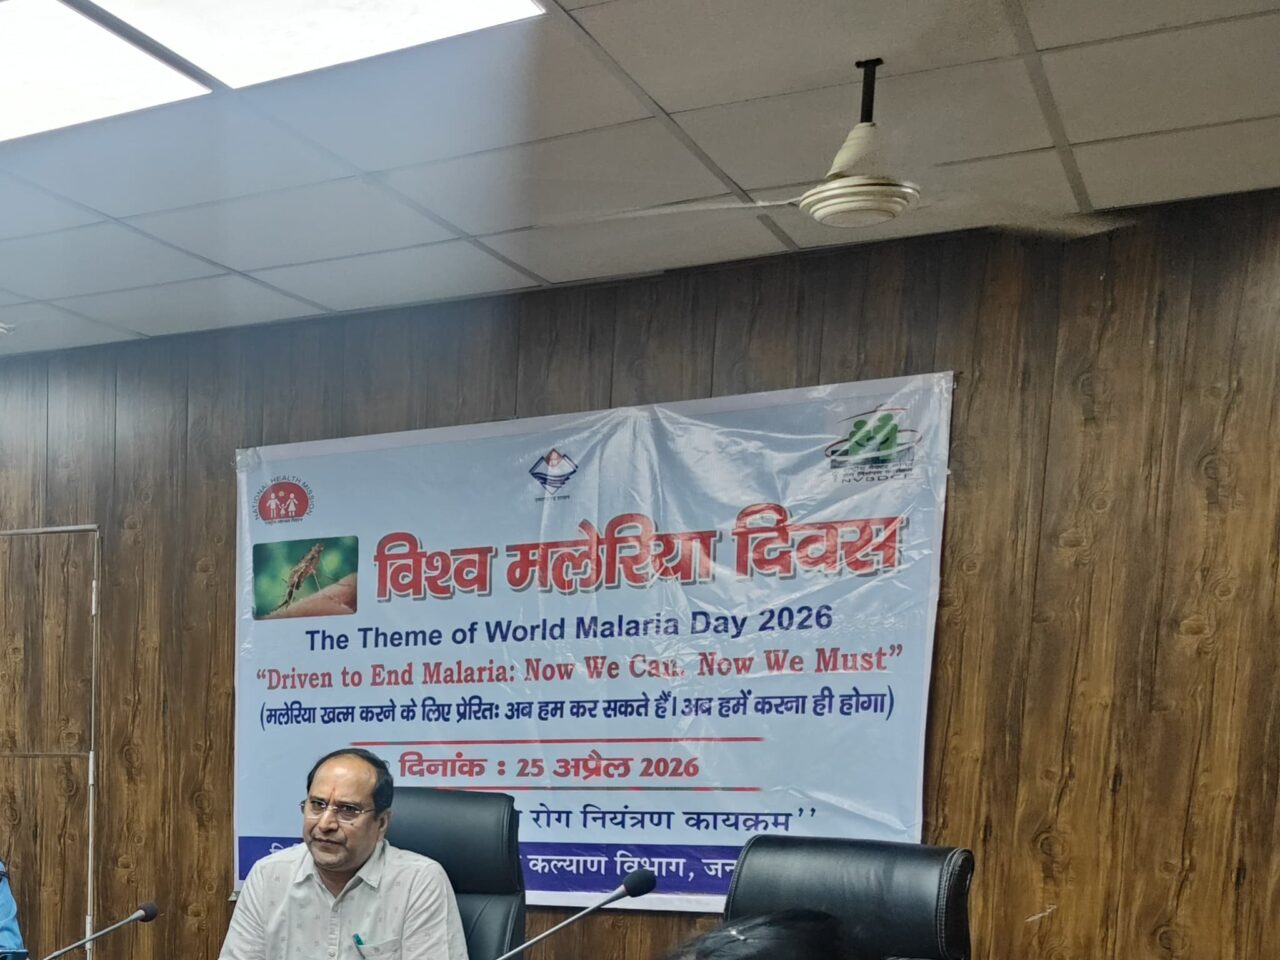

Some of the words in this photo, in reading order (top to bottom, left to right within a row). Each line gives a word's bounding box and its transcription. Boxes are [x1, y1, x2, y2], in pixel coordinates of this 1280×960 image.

[270, 474, 302, 484] HEALTH
[373, 531, 497, 602] विश्व
[505, 513, 720, 595] मलेरिया
[731, 502, 909, 580] दिवस
[305, 630, 349, 651] The
[357, 627, 443, 649] Theme
[451, 621, 479, 644] of
[485, 617, 566, 643] World
[575, 613, 680, 639] Malaria
[690, 609, 748, 639] Day
[758, 604, 833, 632] 2026
[256, 667, 333, 690] “Driven
[341, 666, 363, 688] to
[370, 663, 414, 687] End
[422, 660, 516, 685] Malaria:
[524, 658, 575, 682] Now
[584, 655, 620, 680] We
[698, 652, 755, 677] Now
[764, 649, 804, 674] We
[814, 644, 903, 673] Must”
[260, 700, 316, 731] (मलेरिया
[320, 705, 355, 725] खत्म
[360, 698, 396, 723] करने
[400, 697, 416, 723] के
[421, 696, 451, 722] लिए
[504, 701, 532, 720] अब
[538, 700, 565, 722] हम
[570, 699, 599, 720] कर
[602, 691, 650, 719] सकते
[681, 696, 713, 718] अब
[717, 689, 752, 719] हमें
[754, 694, 807, 718] करना
[812, 686, 834, 718] ही
[839, 684, 895, 721] होगा)
[398, 751, 488, 778] दिनांक
[515, 758, 545, 778] 25
[552, 749, 634, 781] अप्रैल
[639, 756, 700, 778] 2026
[529, 802, 573, 829] रोग
[580, 803, 675, 830] नियंत्रण
[526, 854, 609, 876] कल्याण
[613, 849, 695, 882] विभाग,
